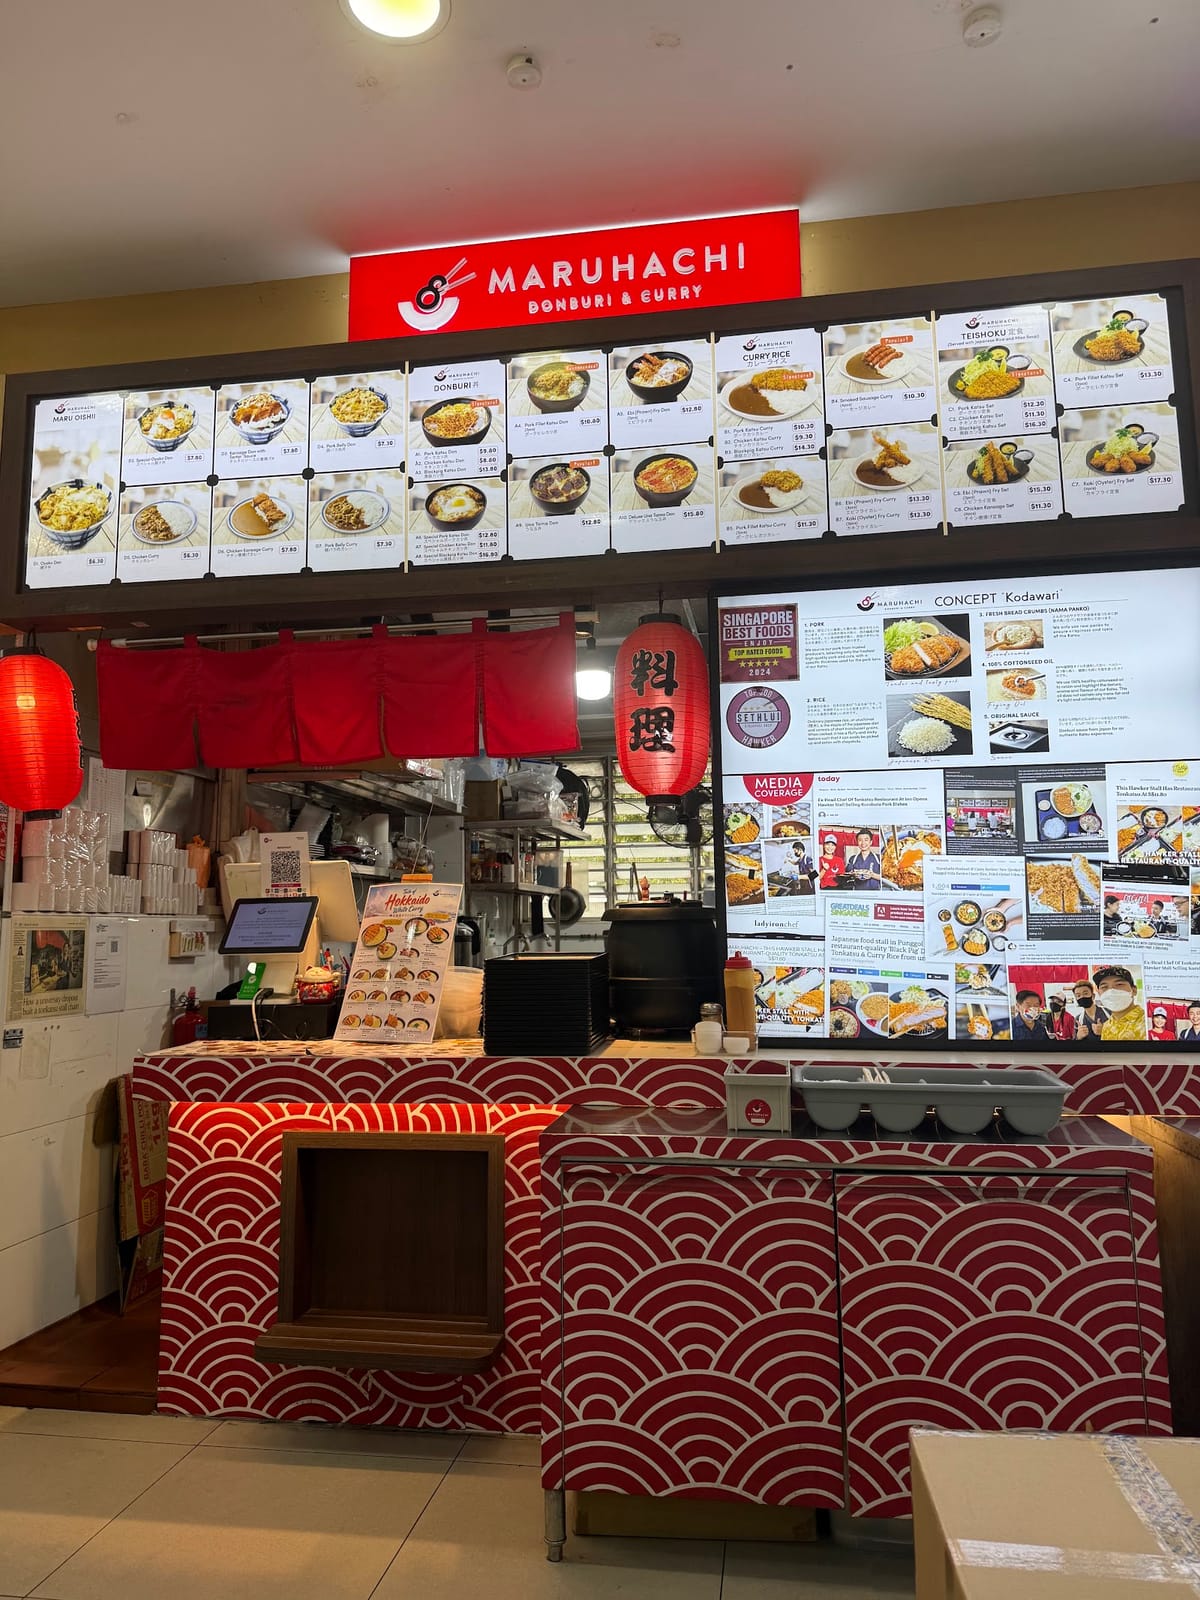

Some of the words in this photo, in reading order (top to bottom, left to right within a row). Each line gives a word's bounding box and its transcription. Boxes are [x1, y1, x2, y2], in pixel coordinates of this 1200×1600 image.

[488, 242, 745, 295] MARUHACHI
[528, 293, 612, 315] DONBURI
[622, 291, 631, 305] &
[641, 284, 703, 302] CURRY
[961, 330, 1006, 340] TEISHOKU
[742, 352, 771, 361] CURRY
[747, 358, 787, 367] カレーライス
[434, 382, 471, 391] DONBURI
[52, 415, 73, 423] MARU
[75, 413, 96, 421] OISHII
[1149, 476, 1171, 484] $17.30
[878, 599, 923, 607] MARUHACHI
[934, 592, 997, 607] CONCEPT
[723, 611, 793, 626] SINGAPORE
[725, 626, 753, 639] BEST
[755, 625, 791, 638] FOODS
[749, 668, 771, 676] 2024
[629, 648, 679, 753] 料理
[737, 712, 780, 722] SETHLUI
[742, 735, 777, 747] HAWKER
[755, 777, 803, 789] MEDIA
[818, 775, 840, 783] today
[754, 788, 803, 798] COVERAGE
[385, 893, 431, 911] Hokkaido
[830, 902, 869, 911] GREATDEALS
[408, 905, 423, 913] Curry
[831, 909, 869, 917] SINGAPORE
[754, 919, 799, 928] ladyironchef
[831, 943, 887, 952] restaurant-quality
[867, 952, 885, 960] Curry
